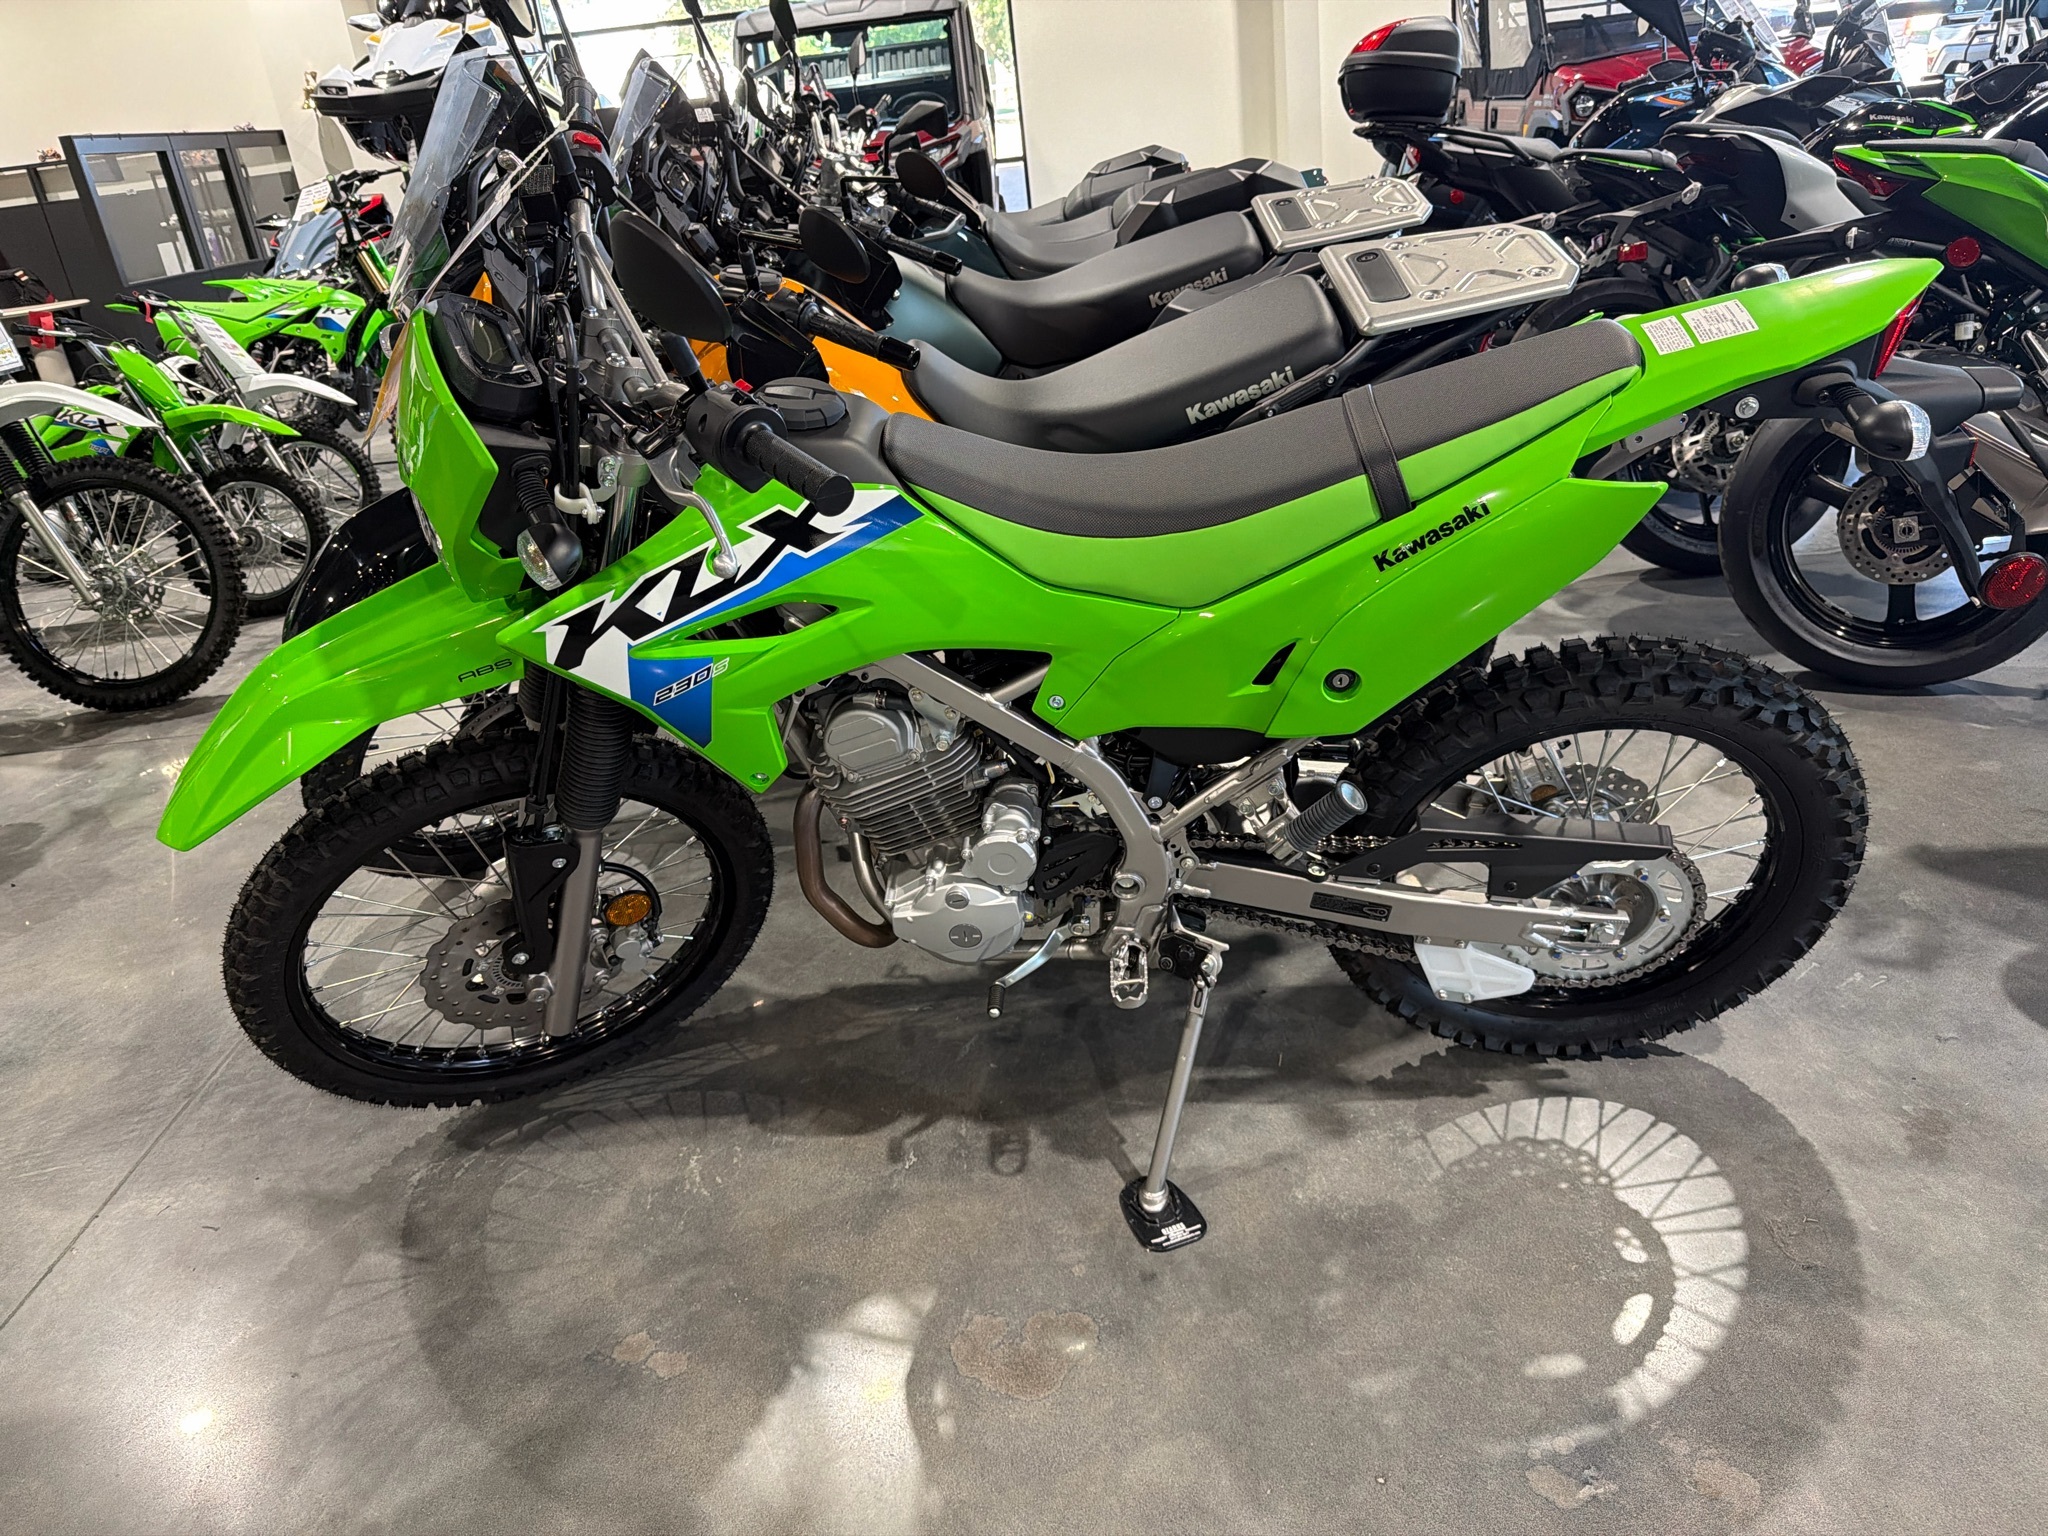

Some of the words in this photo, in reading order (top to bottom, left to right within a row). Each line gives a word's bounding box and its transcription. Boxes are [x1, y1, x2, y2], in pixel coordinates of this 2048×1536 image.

[1869, 113, 1915, 124] Kawasaki
[322, 307, 358, 316] KX
[1185, 365, 1296, 425] Kawasaki
[55, 408, 118, 436] KLX
[1372, 500, 1491, 573] Kawasaki
[551, 502, 850, 671] KLX
[457, 658, 513, 683] ABS
[653, 657, 730, 706] 230S
